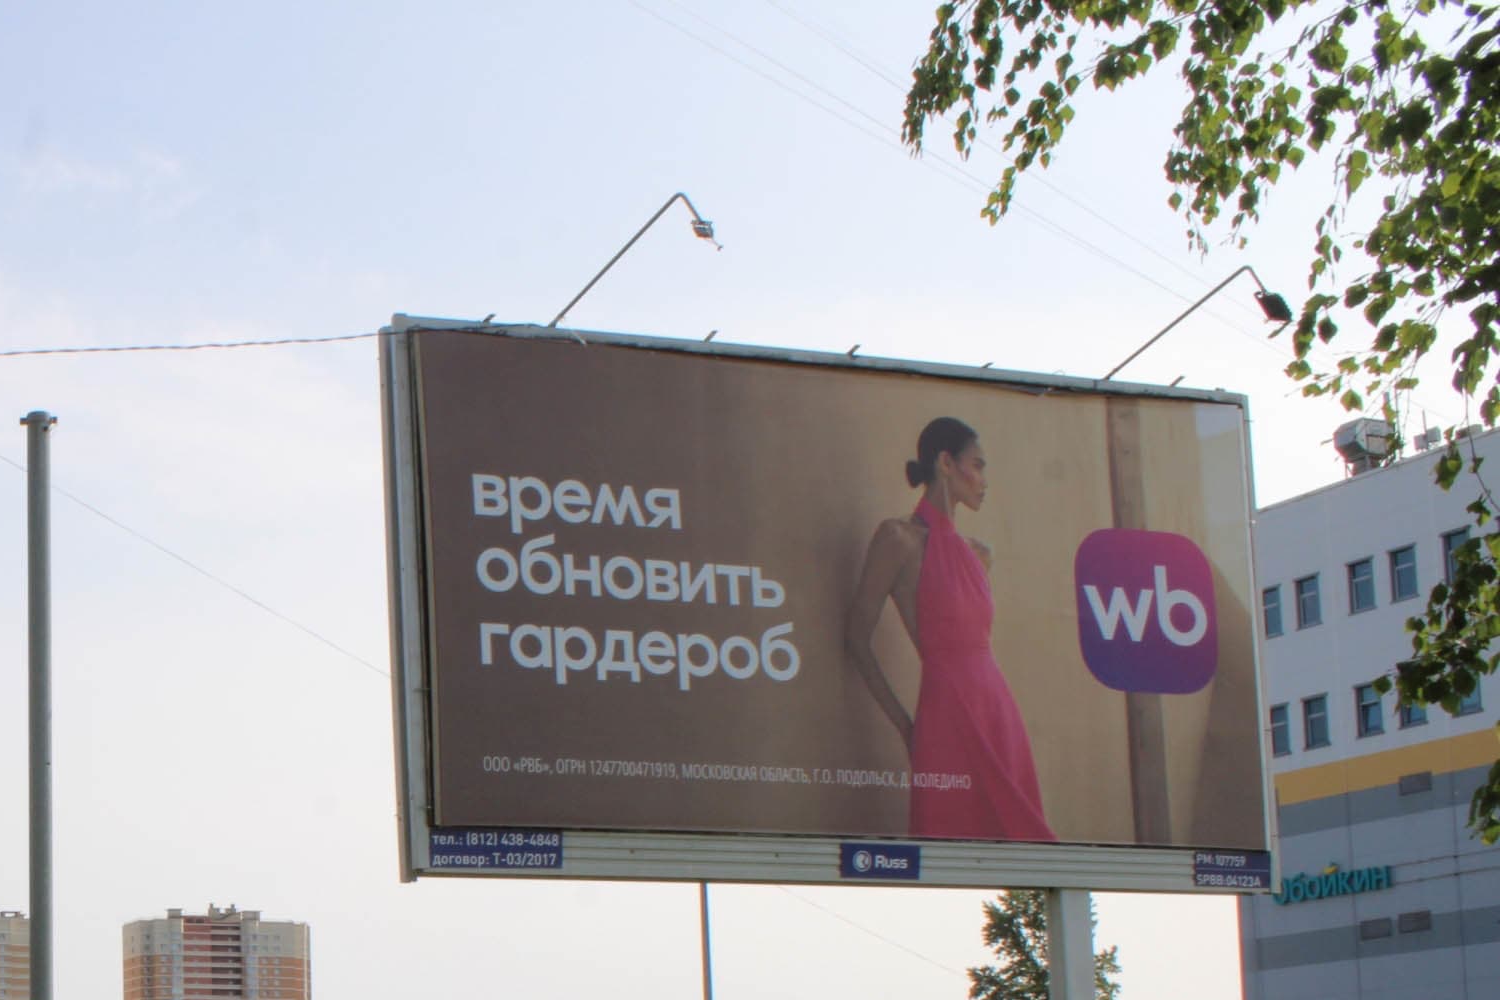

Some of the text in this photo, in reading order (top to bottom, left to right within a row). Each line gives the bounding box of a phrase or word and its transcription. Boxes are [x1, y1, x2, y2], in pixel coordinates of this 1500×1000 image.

[472, 473, 682, 533] время
[476, 534, 786, 608] обновить
[1083, 565, 1208, 647] wb
[480, 622, 800, 691] гардероб
[483, 756, 510, 773] ООО
[513, 757, 553, 775] «РВБ»,
[556, 758, 587, 775] ОГРН
[682, 763, 758, 781] МОСКОВСКАЯ
[913, 771, 972, 790] КОЛЕДИНО
[431, 832, 560, 847] тел.: (812) 438-4848
[432, 852, 557, 868] договор: Т-03/2017
[874, 854, 909, 869] Russ
